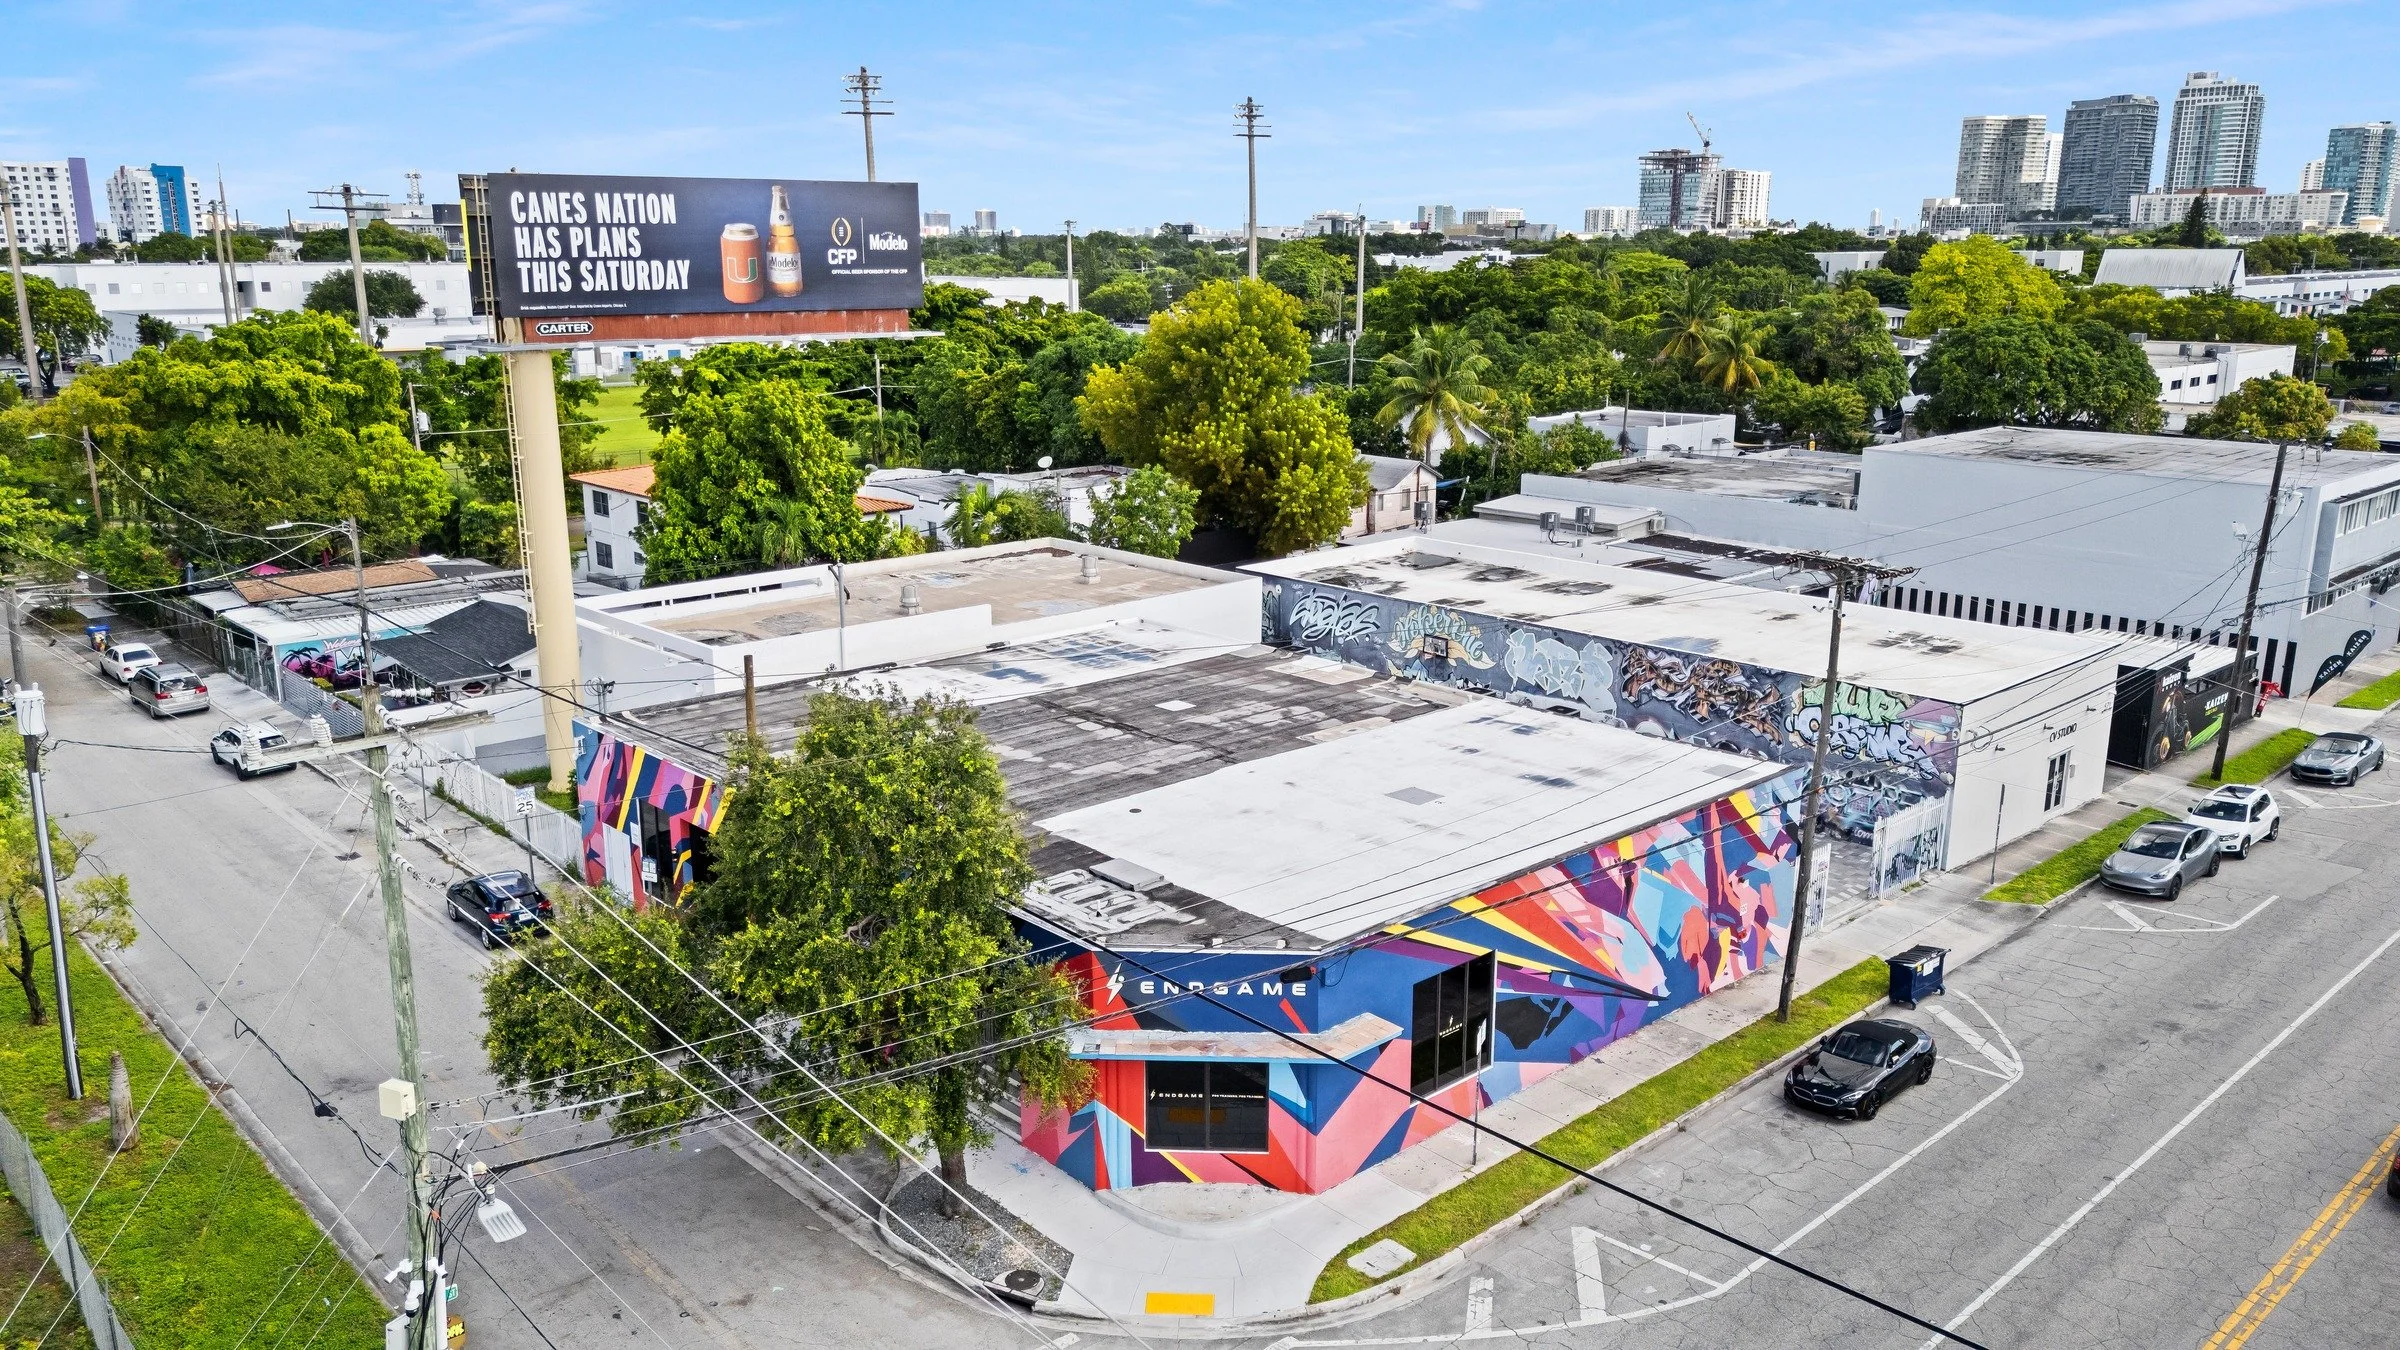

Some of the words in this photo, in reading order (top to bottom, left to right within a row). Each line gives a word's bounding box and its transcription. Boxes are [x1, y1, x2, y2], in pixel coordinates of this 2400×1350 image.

[510, 191, 588, 224] CANES
[594, 192, 677, 224] NATION
[513, 226, 562, 258] HAS
[569, 226, 642, 258] PLANS
[869, 233, 908, 250] Modelo
[770, 257, 798, 268] Modelo
[827, 248, 858, 264] CFP
[516, 260, 572, 293] THIS
[579, 259, 691, 292] SATURDAY
[727, 257, 759, 283] U
[539, 323, 589, 334] CARTER
[2346, 634, 2367, 657] KAIZEN
[2318, 659, 2343, 680] KAIZEN
[2205, 692, 2229, 711] KAIZEN
[2057, 722, 2078, 740] STUDIO
[518, 801, 533, 812] 25
[1140, 981, 1307, 996] ENDGAME
